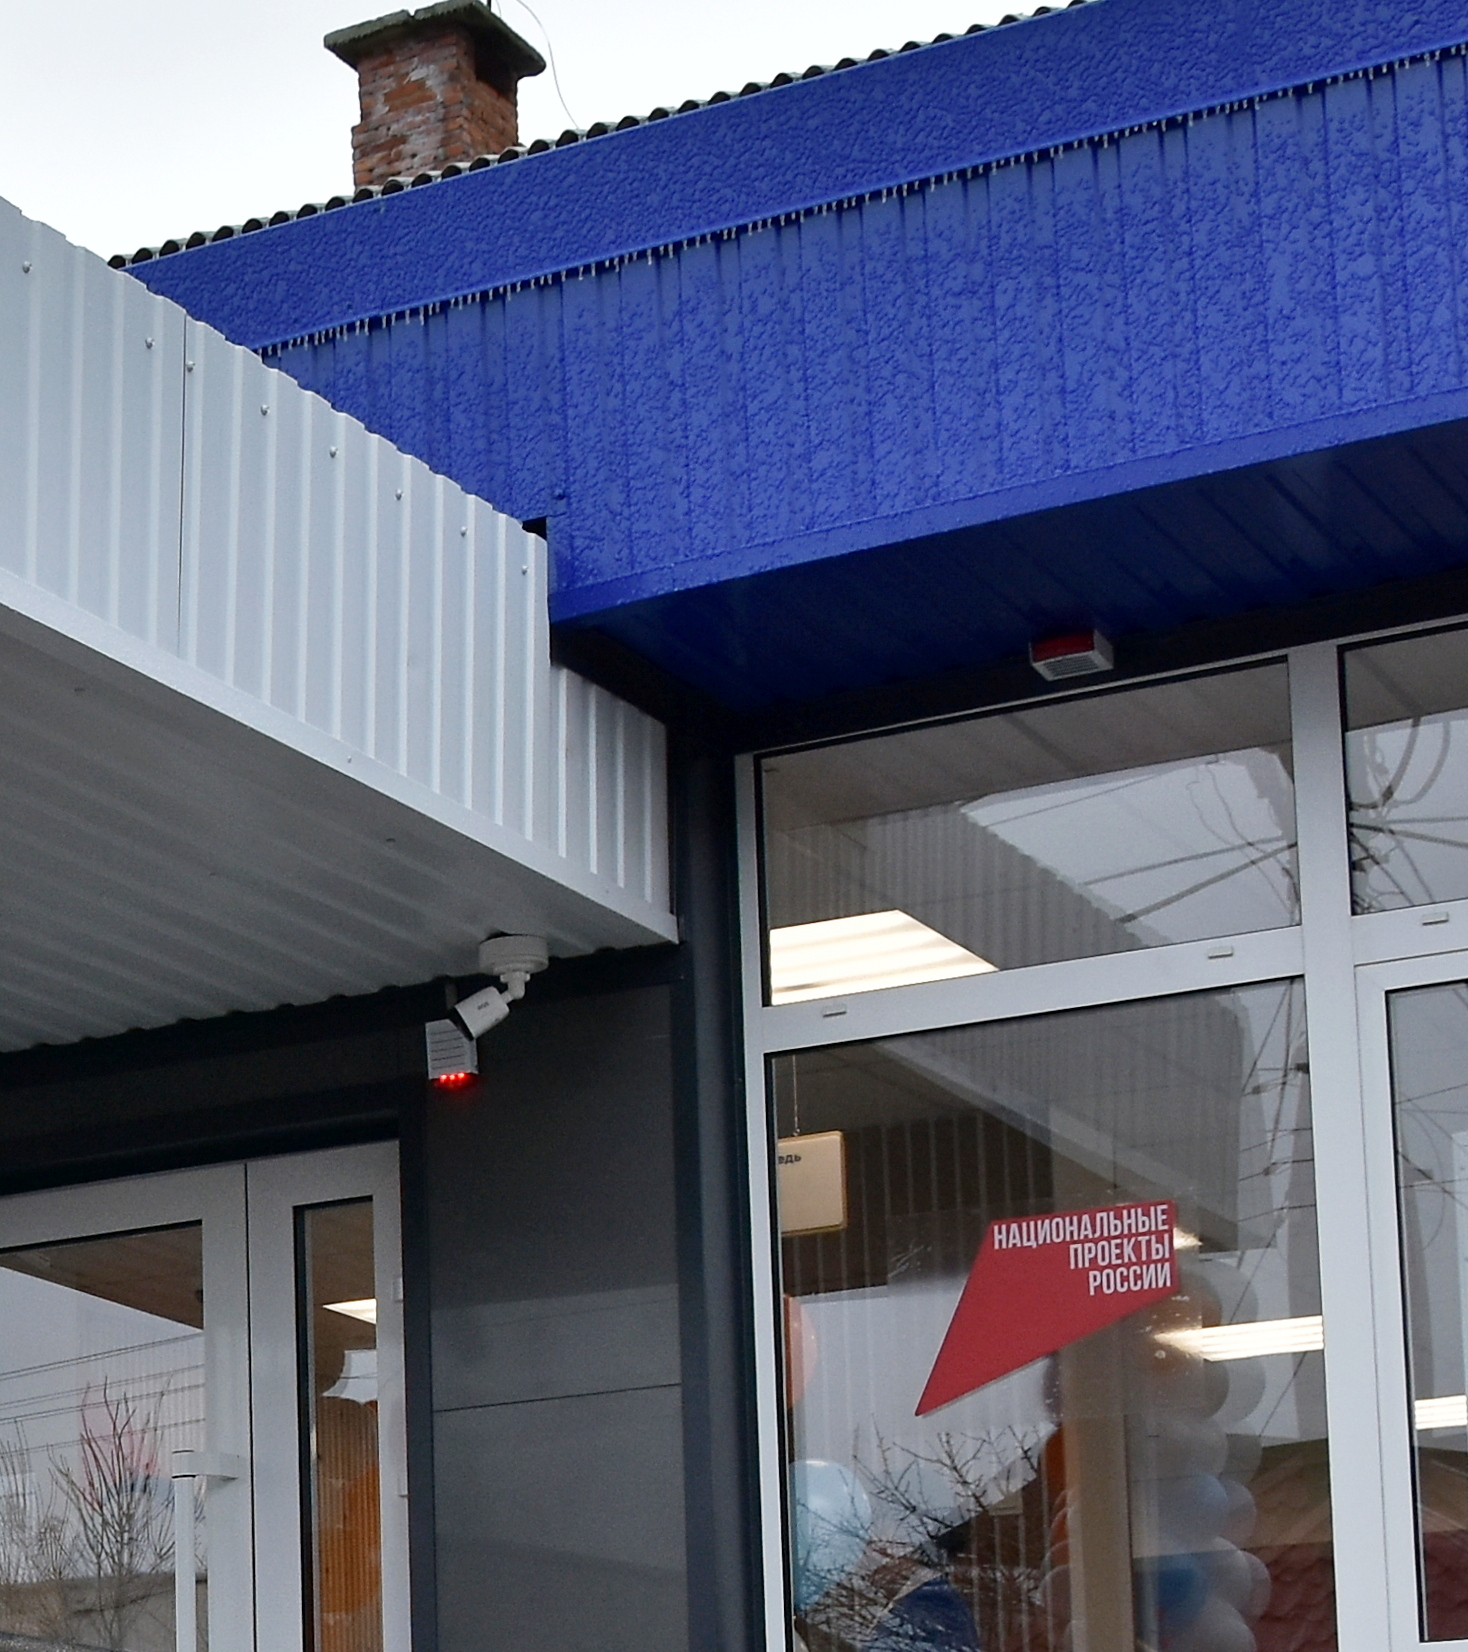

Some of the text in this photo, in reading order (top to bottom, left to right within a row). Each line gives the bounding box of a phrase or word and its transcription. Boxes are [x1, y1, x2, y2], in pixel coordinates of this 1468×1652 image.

[993, 1204, 1169, 1250] НАЦИОНАЛЬНЫЕ
[1069, 1233, 1170, 1270] ПРОЕКТЫ
[1088, 1262, 1172, 1297] РОССИИ
